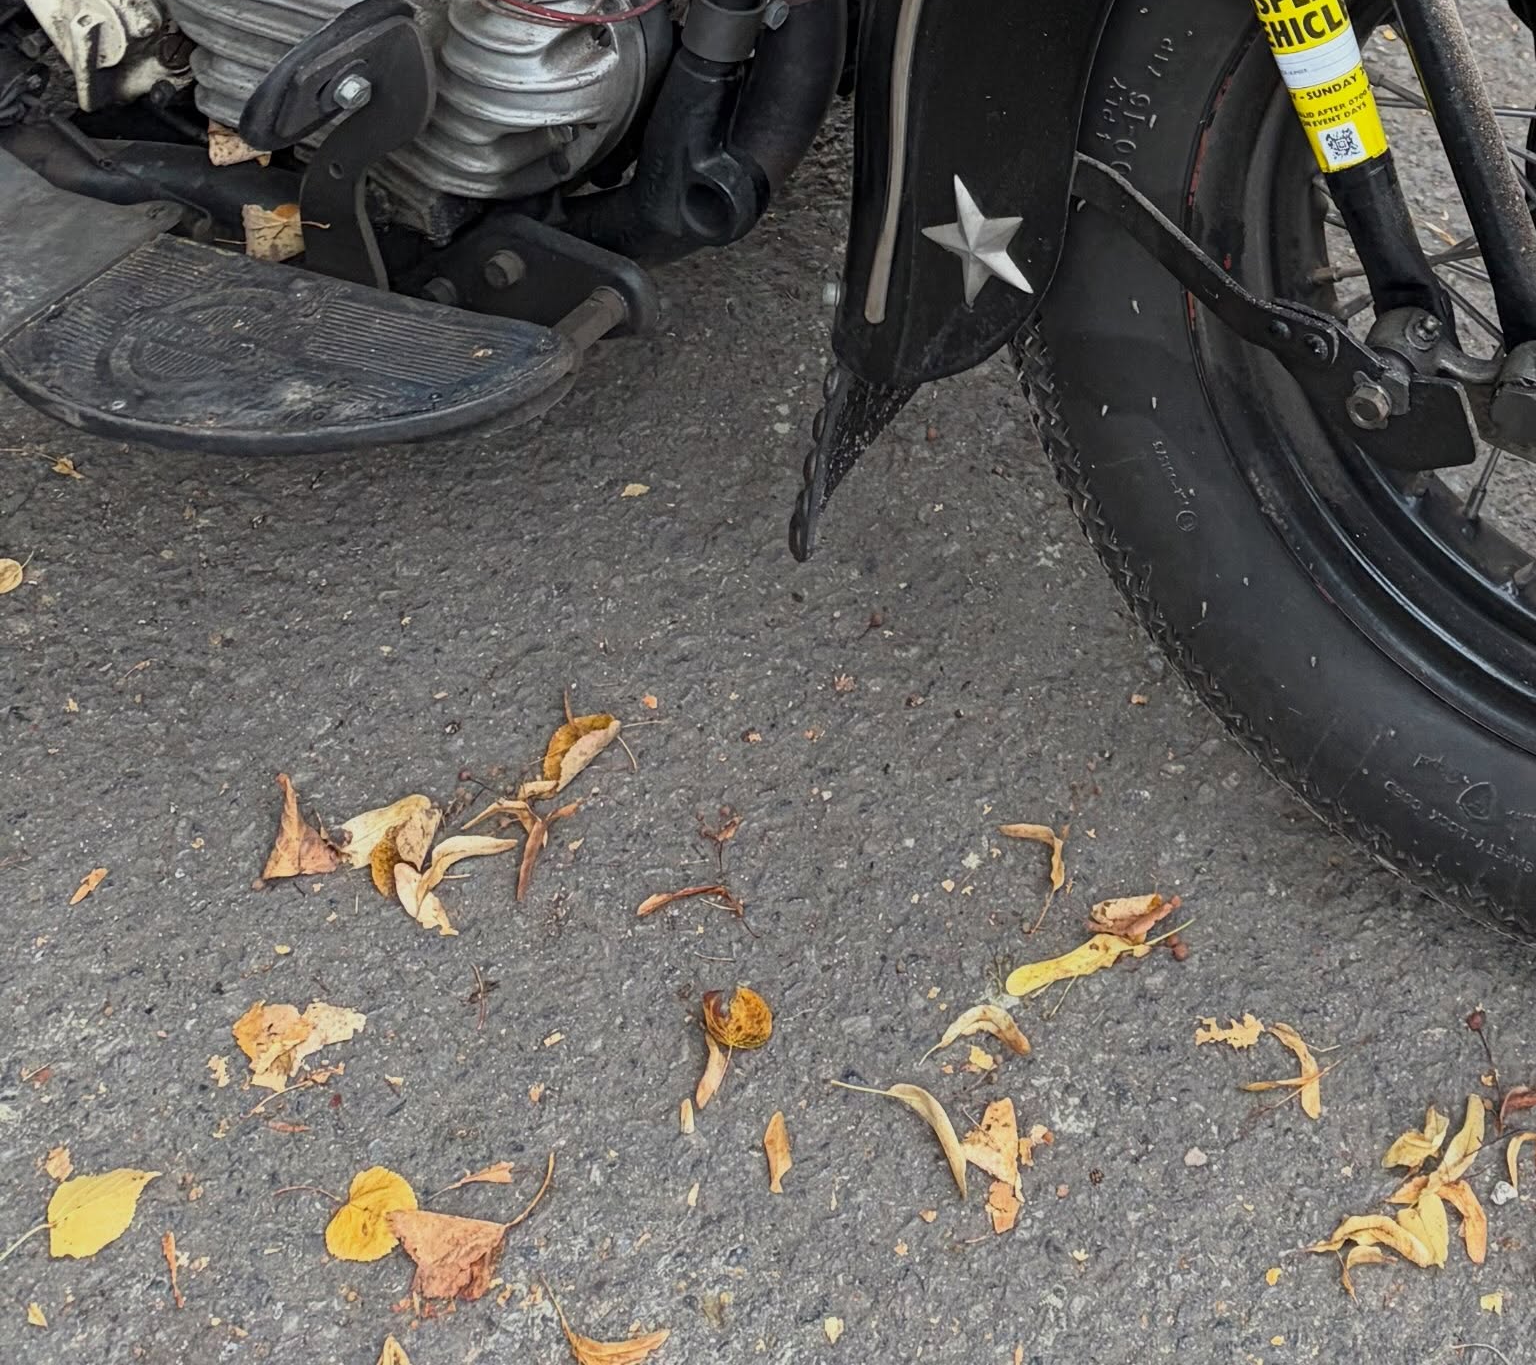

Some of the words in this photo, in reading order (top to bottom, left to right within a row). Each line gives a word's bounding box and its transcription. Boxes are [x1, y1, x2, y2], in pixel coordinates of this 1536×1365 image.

[1306, 72, 1359, 101] SUNDAY
[1312, 114, 1341, 127] EVENT
[1344, 101, 1367, 118] DAYS
[1317, 102, 1346, 117] AFTER
